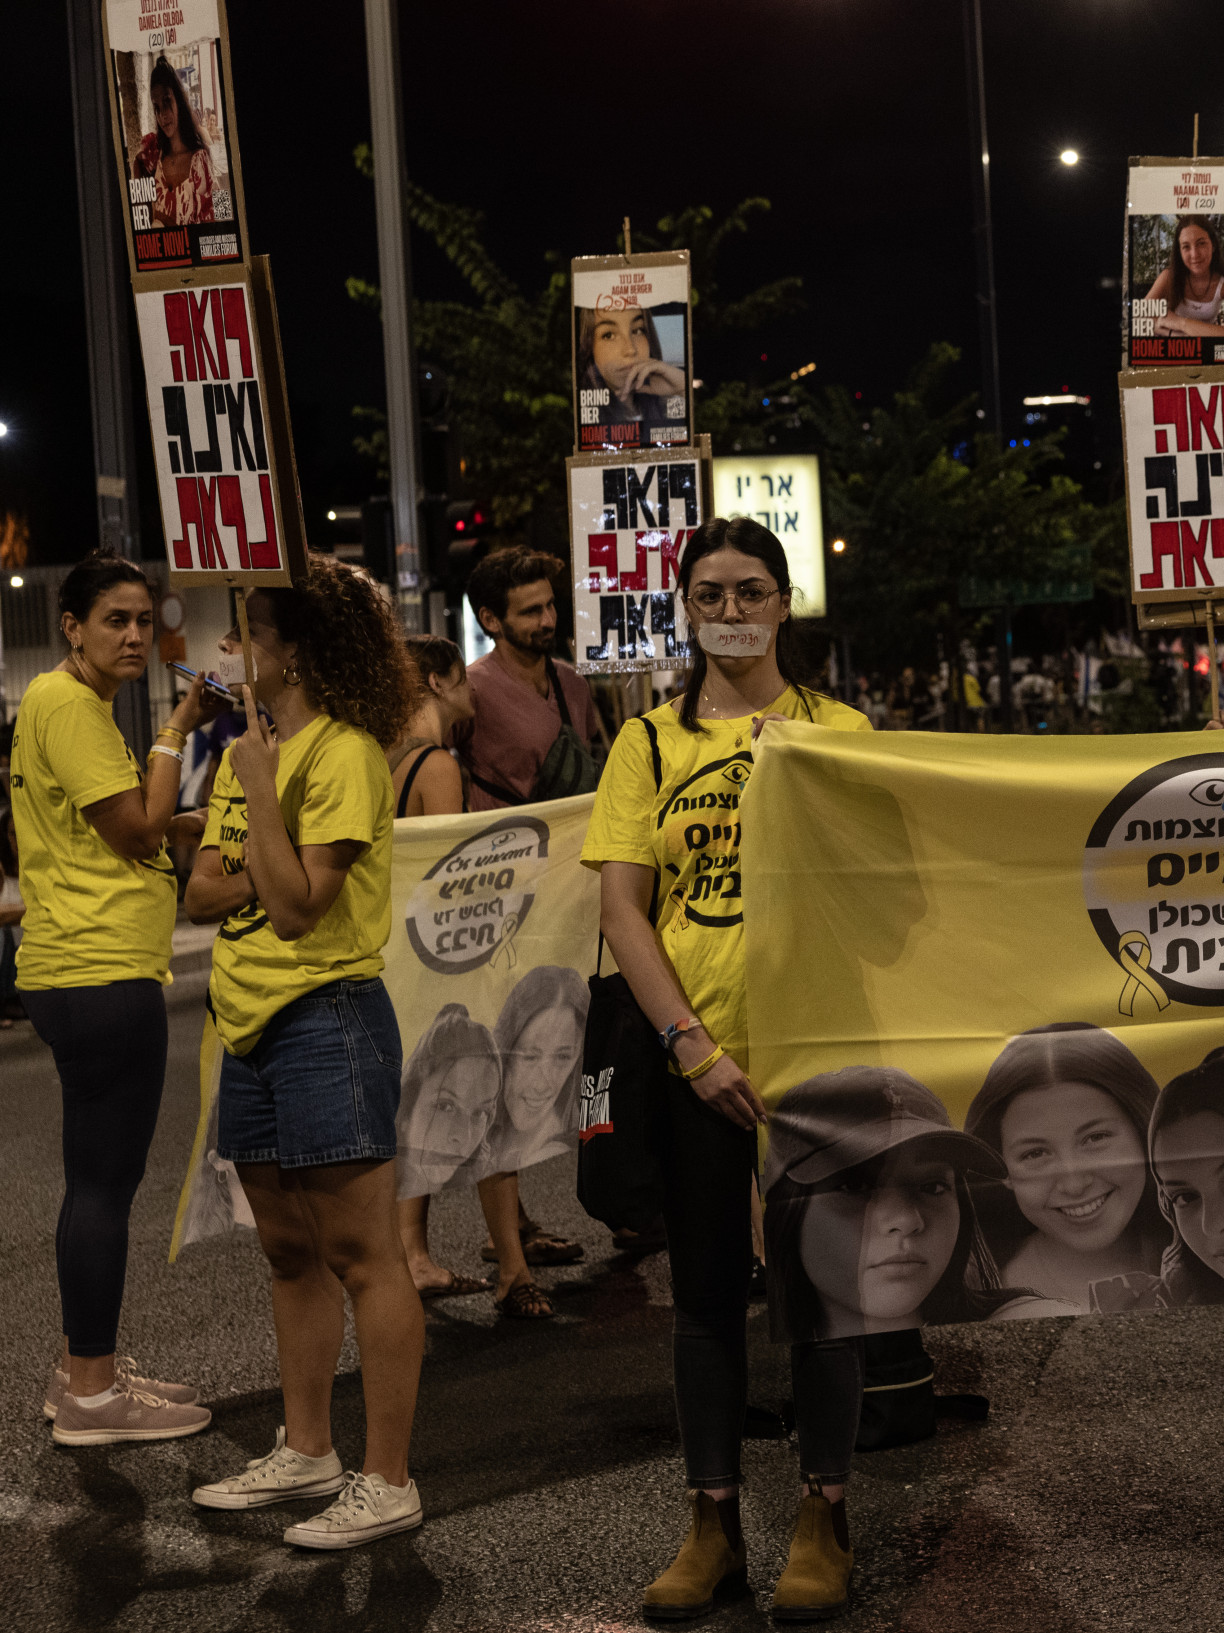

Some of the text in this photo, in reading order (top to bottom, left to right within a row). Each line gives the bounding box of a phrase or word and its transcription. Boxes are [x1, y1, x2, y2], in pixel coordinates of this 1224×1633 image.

[139, 10, 185, 31] DANIELA GILBOA
[148, 33, 165, 48] (20)
[129, 176, 157, 204] BRING
[1173, 185, 1219, 196] NAAMA LEVY
[1195, 199, 1215, 209] (20)
[132, 204, 152, 231] HER
[136, 226, 191, 259] HOME NOW!
[612, 283, 653, 295] AGAM BERGER
[1132, 299, 1168, 318] BRING
[163, 287, 254, 382] רואה
[1132, 318, 1154, 336] HER
[1132, 337, 1202, 358] HOME NOW!
[580, 388, 610, 407] BRING
[161, 380, 269, 474] ואינה
[580, 407, 600, 425] HER
[581, 425, 609, 443] HOME
[611, 421, 640, 441] NOW!
[602, 463, 698, 530] רואה
[172, 473, 281, 569] נראת
[588, 529, 697, 593] אינה
[671, 792, 740, 815] וצמות
[688, 871, 742, 901] בית
